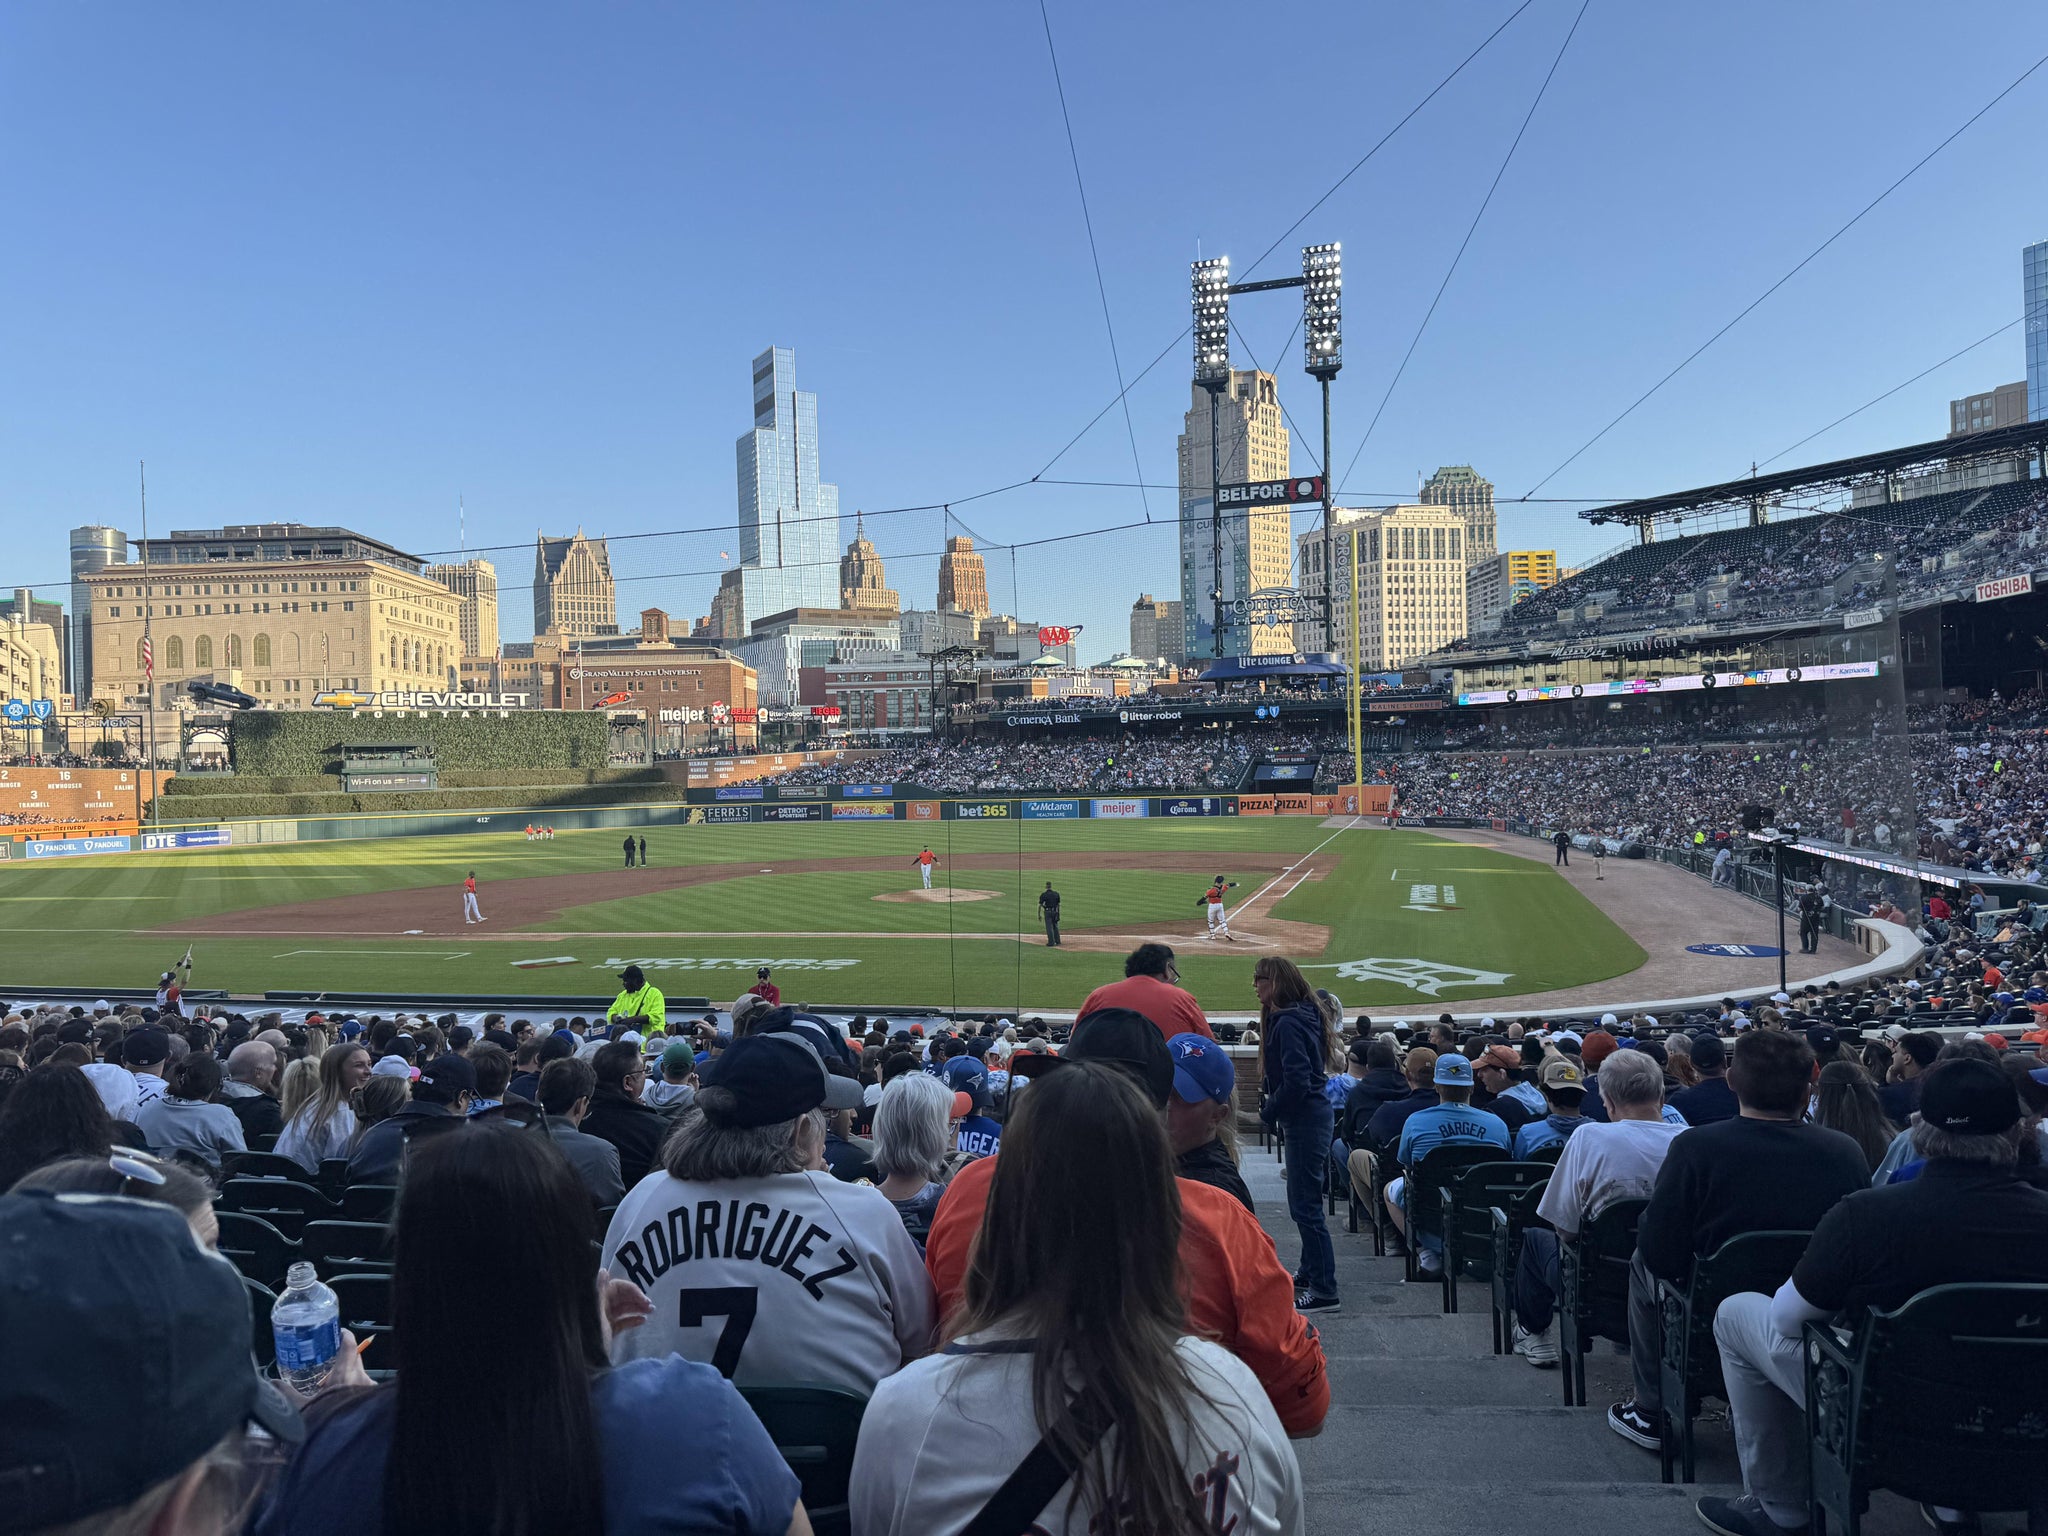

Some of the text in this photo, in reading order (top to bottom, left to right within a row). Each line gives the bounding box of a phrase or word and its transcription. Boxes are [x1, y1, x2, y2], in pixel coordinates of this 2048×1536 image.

[1219, 484, 1285, 502] BELFOR
[1977, 576, 2029, 600] TOSHIBA
[1042, 627, 1069, 641] AAA
[1616, 637, 1678, 652] TIGER CLUB
[1257, 656, 1291, 666] LOUNGE
[582, 669, 608, 677] GRAND
[608, 669, 635, 677] VALLEY
[635, 669, 657, 677] STATE
[1728, 671, 1772, 685] TOR DET
[380, 692, 531, 708] CHEVROLET
[659, 707, 705, 724] meijer
[730, 707, 757, 715] BELLE
[734, 715, 754, 723] TIRE
[822, 715, 841, 723] LAW
[1055, 714, 1081, 724] Bank
[774, 756, 783, 764] 10
[806, 753, 813, 761] 11
[835, 752, 844, 760] 42
[1, 770, 128, 782] 2 16 6
[351, 777, 372, 785] Wi-Fi
[30, 790, 38, 799] 3
[96, 790, 101, 799] 1
[1040, 802, 1073, 811] McLaren
[1102, 802, 1136, 816] meijer
[1240, 800, 1273, 810] PIZZA!
[1276, 799, 1307, 809] PIZZA!
[1372, 801, 1389, 812] Littl
[707, 807, 749, 817] FERRIS
[836, 806, 870, 816] Surfside
[916, 805, 930, 817] hop
[959, 805, 1008, 817] bet365
[1169, 805, 1197, 815] Corona
[45, 841, 124, 852] FANDUEL FANDUEL
[145, 834, 176, 849] DTE
[1438, 1121, 1487, 1140] BARGER
[957, 1131, 1001, 1155] NGER
[615, 1199, 859, 1302] RODRIGUEZ
[679, 1287, 758, 1379] 7
